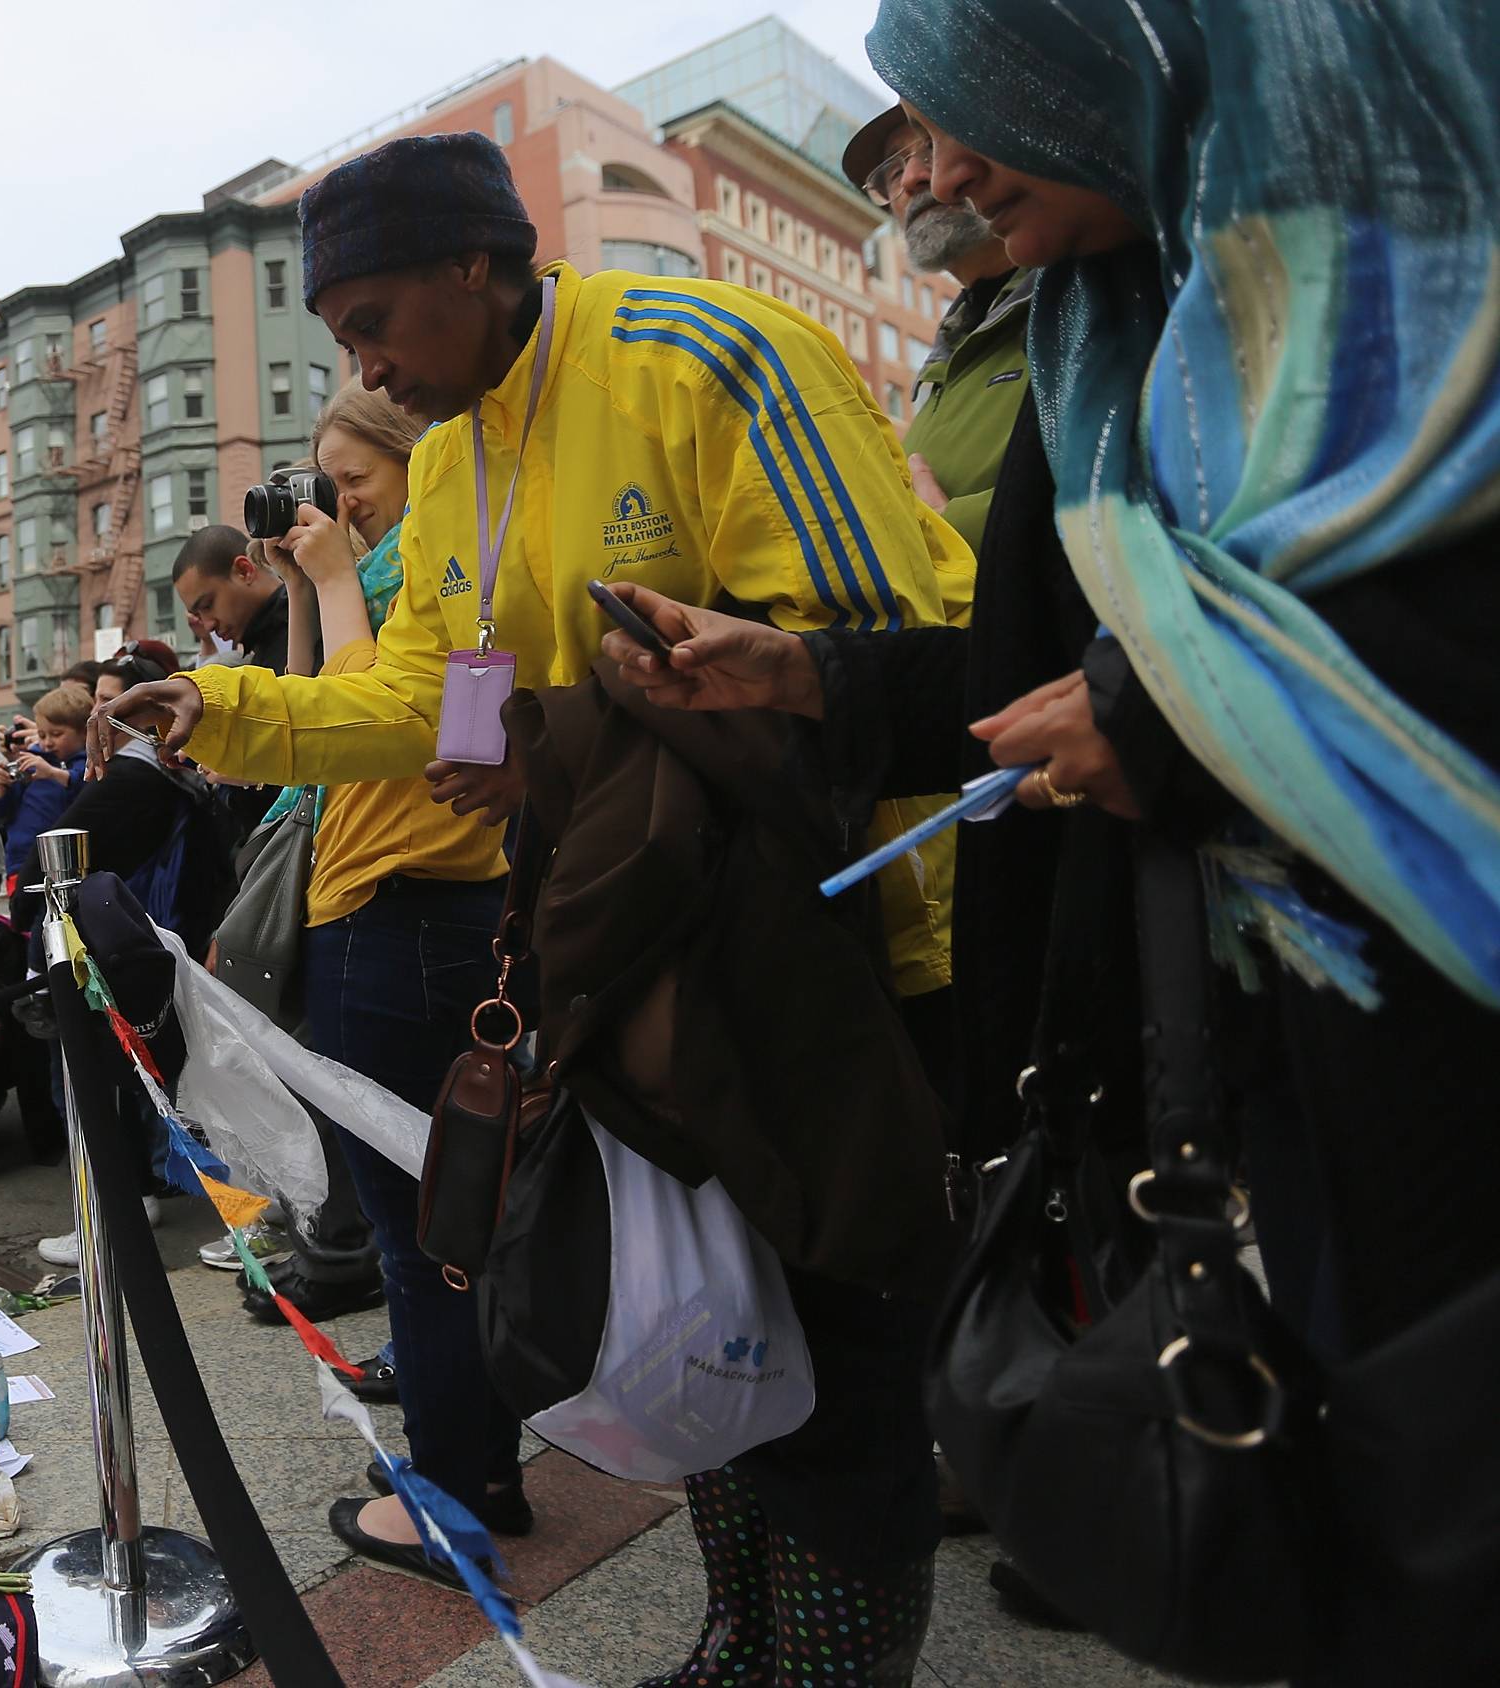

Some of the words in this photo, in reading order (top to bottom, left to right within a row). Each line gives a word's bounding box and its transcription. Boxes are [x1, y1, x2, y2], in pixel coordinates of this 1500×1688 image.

[603, 523, 628, 535] 2013
[631, 513, 669, 531] BOSTON
[604, 524, 673, 546] MARATHON
[602, 551, 632, 578] John
[440, 580, 472, 597] adidas
